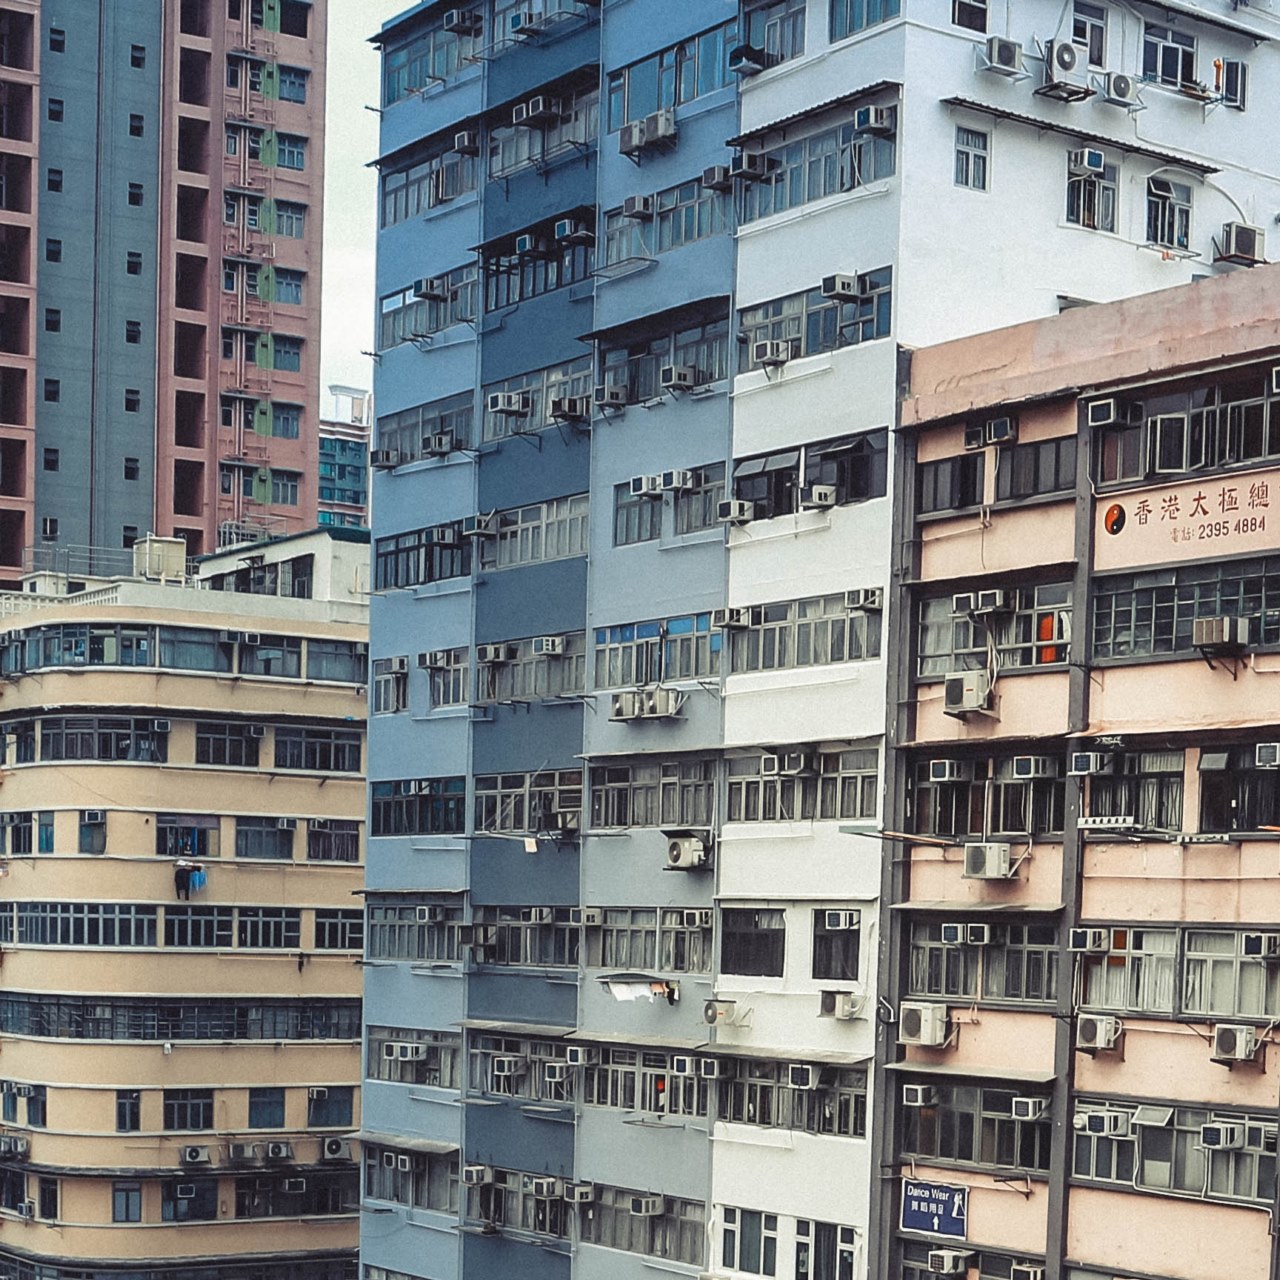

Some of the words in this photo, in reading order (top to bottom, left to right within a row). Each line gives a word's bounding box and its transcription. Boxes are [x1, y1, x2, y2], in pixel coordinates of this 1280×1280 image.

[1198, 521, 1229, 540] 2395
[1234, 515, 1266, 534] 4884
[907, 1185, 929, 1199] Dance
[931, 1188, 950, 1201] Wear
